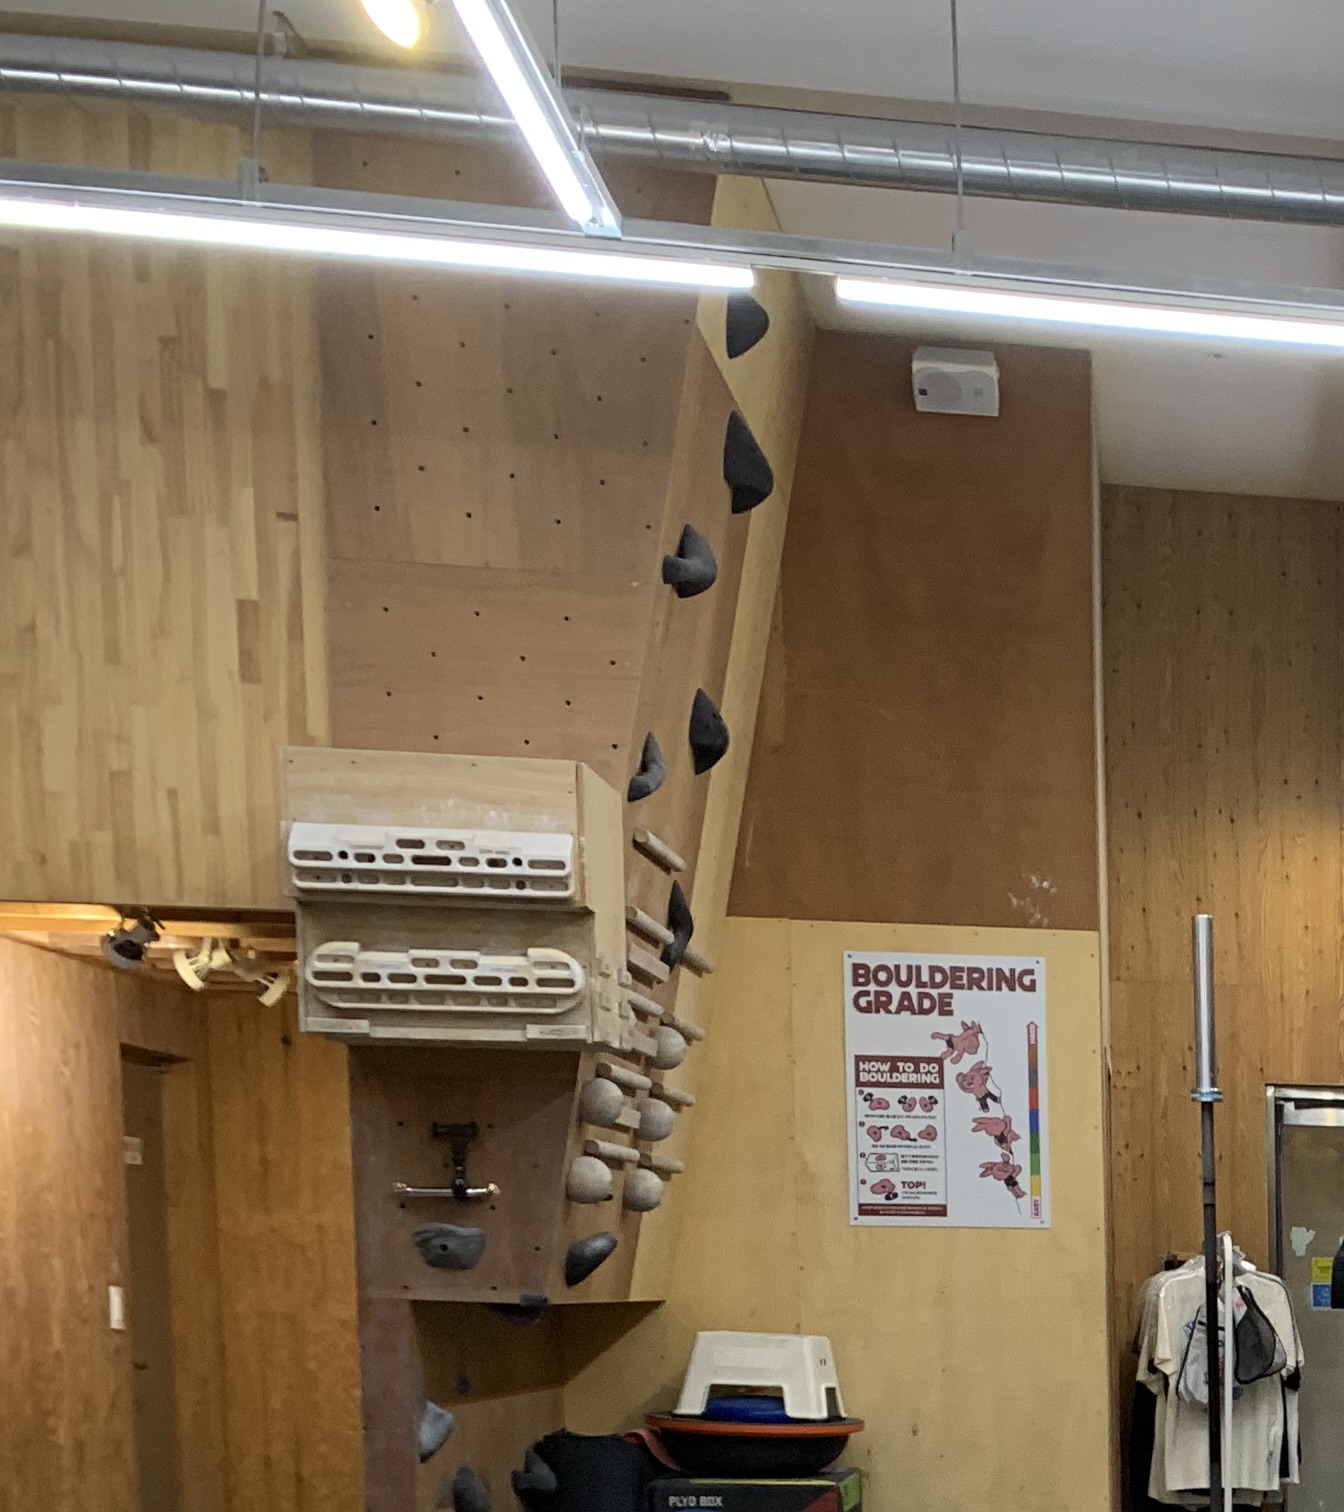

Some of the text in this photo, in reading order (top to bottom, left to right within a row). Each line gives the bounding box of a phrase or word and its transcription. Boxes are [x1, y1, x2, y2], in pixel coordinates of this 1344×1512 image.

[852, 963, 1036, 992] BOULDERING
[852, 990, 954, 1016] GRADE
[859, 1061, 939, 1074] HOW TO DO
[859, 1072, 940, 1084] BOULDERING
[901, 1181, 927, 1190] TOP!
[668, 1495, 723, 1507] PLYO BOX
